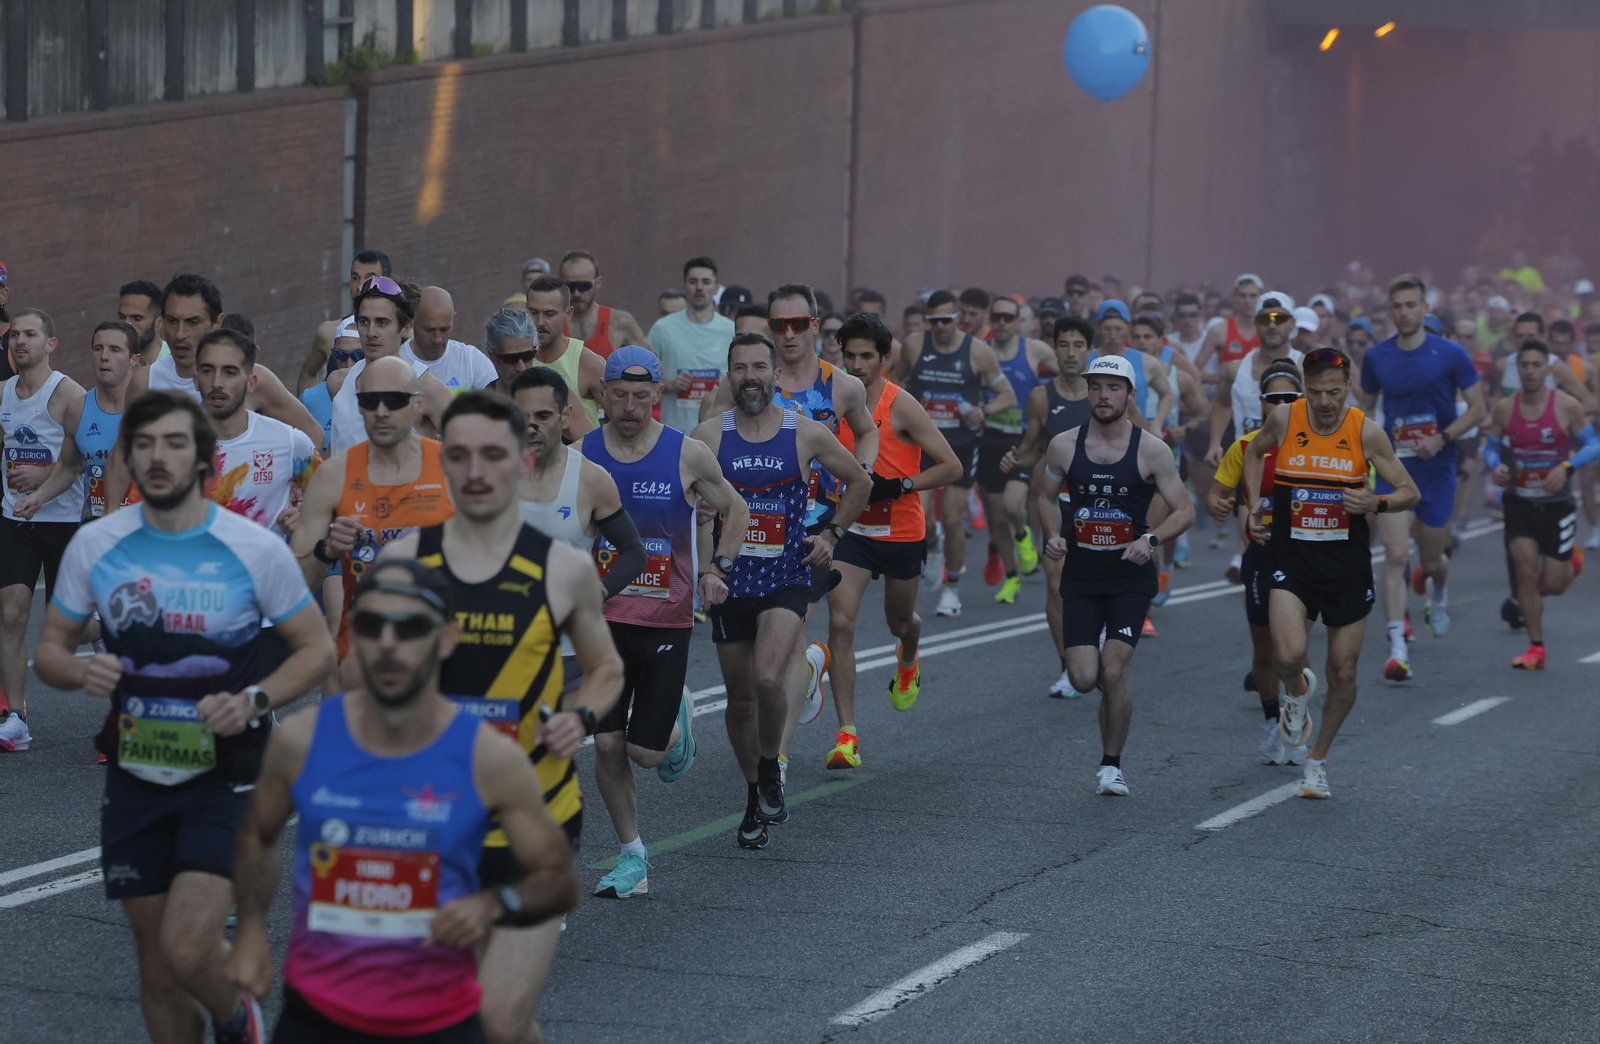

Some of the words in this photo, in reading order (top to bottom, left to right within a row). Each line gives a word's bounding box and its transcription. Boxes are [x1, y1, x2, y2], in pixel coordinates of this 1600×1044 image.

[1093, 361, 1119, 370] HOKA
[20, 451, 46, 459] ZURICH
[732, 457, 785, 471] MEAUX
[1289, 454, 1306, 466] e3
[1310, 455, 1353, 472] TEAM
[253, 471, 273, 482] OTSO
[1312, 492, 1344, 500] ZURICH
[748, 502, 778, 511] URICH
[1093, 511, 1125, 519] ZURICH
[1301, 516, 1339, 528] EMILIO
[744, 530, 766, 542] RED
[1092, 534, 1117, 544] ERIC
[642, 542, 662, 551] ICH
[165, 587, 224, 612] PATOU
[164, 612, 207, 633] TRAIL
[454, 612, 515, 631] THAM
[483, 633, 514, 646] CLUB
[354, 825, 427, 848] ZURICH
[334, 878, 414, 909] PEDRO
